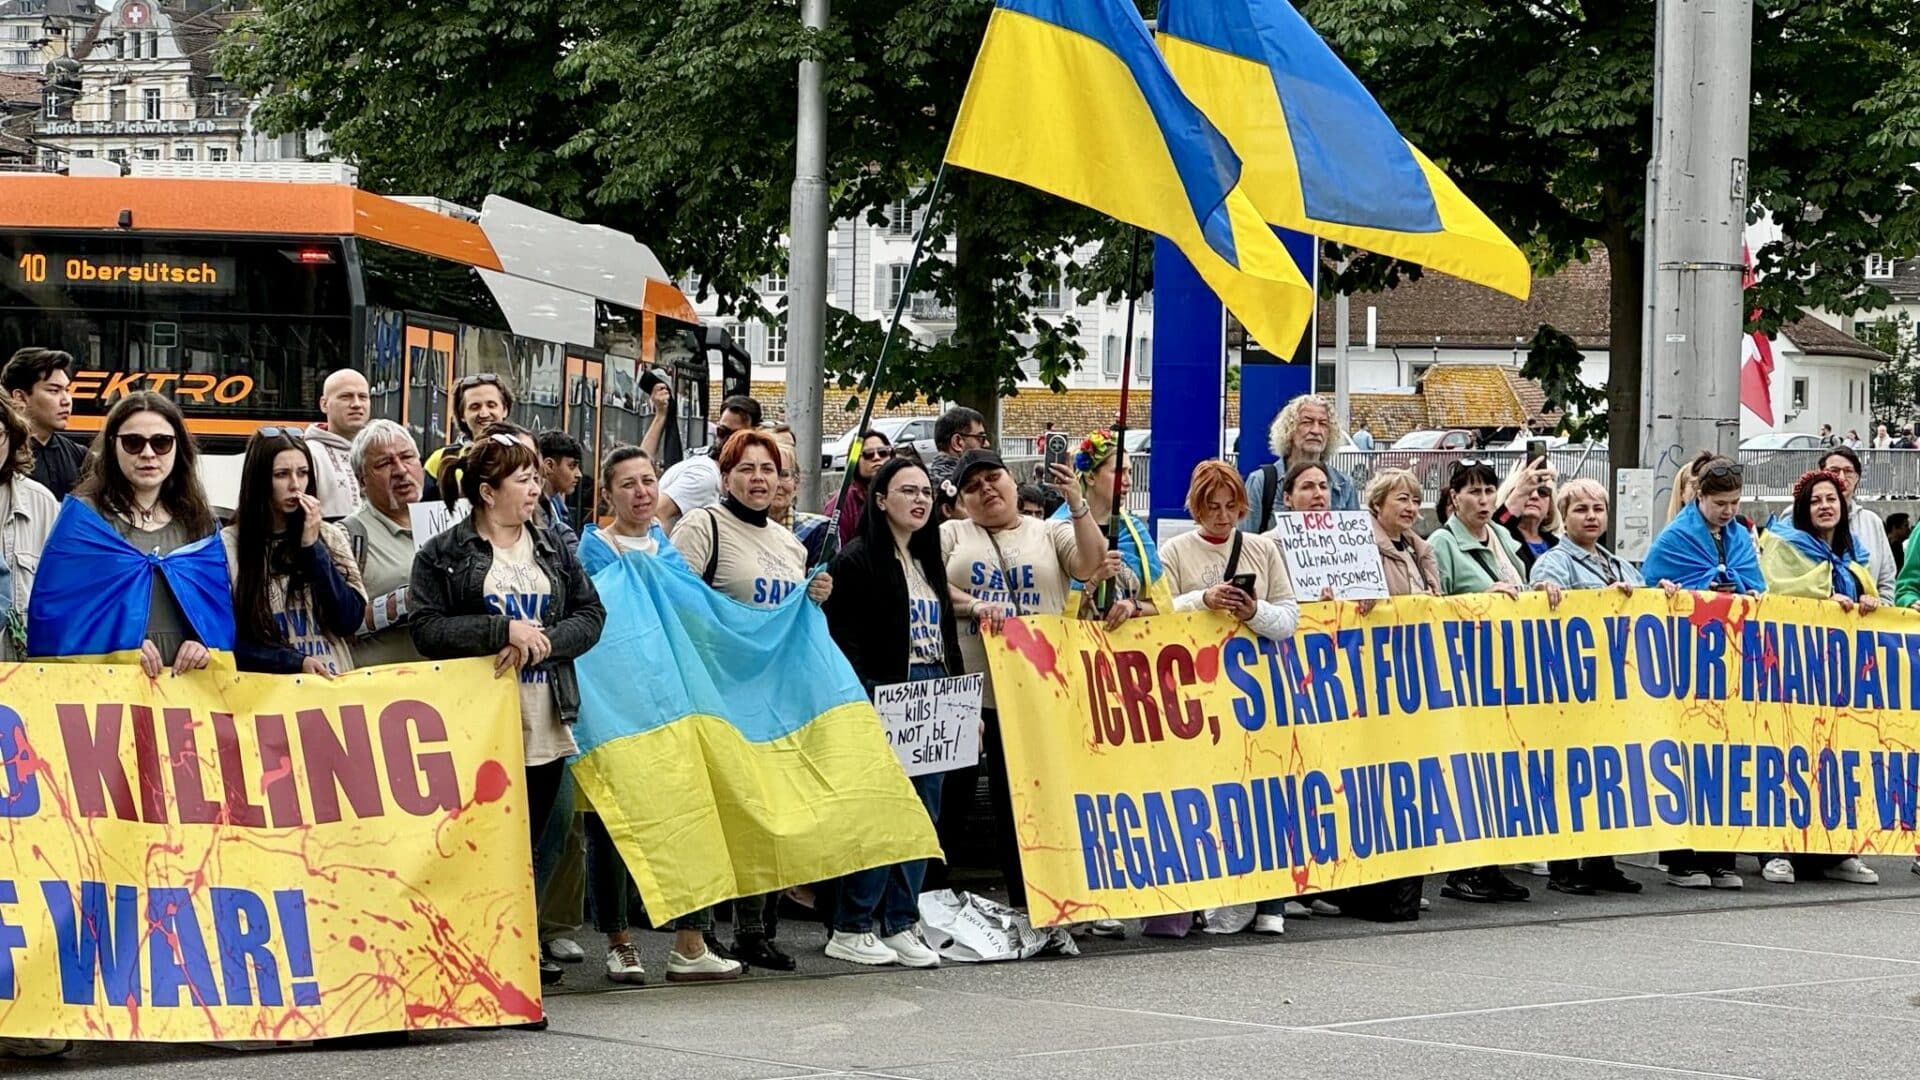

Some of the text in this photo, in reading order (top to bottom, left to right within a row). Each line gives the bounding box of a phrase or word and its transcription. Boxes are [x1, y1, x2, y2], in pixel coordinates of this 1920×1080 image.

[46, 121, 81, 134] Hotel
[116, 119, 178, 133] Pickwick
[188, 120, 216, 133] Pub
[19, 253, 216, 283] 10 Obergütsch
[66, 371, 254, 404] EKTRO
[1278, 512, 1368, 535] The ICRC does
[1338, 531, 1376, 546] about
[970, 561, 1035, 590] SAVE
[1296, 575, 1321, 588] war
[753, 577, 796, 605] SAV
[1080, 643, 1220, 746] ICRC,
[1222, 627, 1368, 732] START
[1371, 616, 1597, 715] FULFILLING
[1603, 614, 1727, 701] YOUR
[897, 724, 924, 746] NOT
[56, 699, 462, 829] KILLING
[1074, 770, 1339, 891] REGARDING
[1818, 747, 1861, 831] OF
[40, 880, 322, 1008] WAR!
